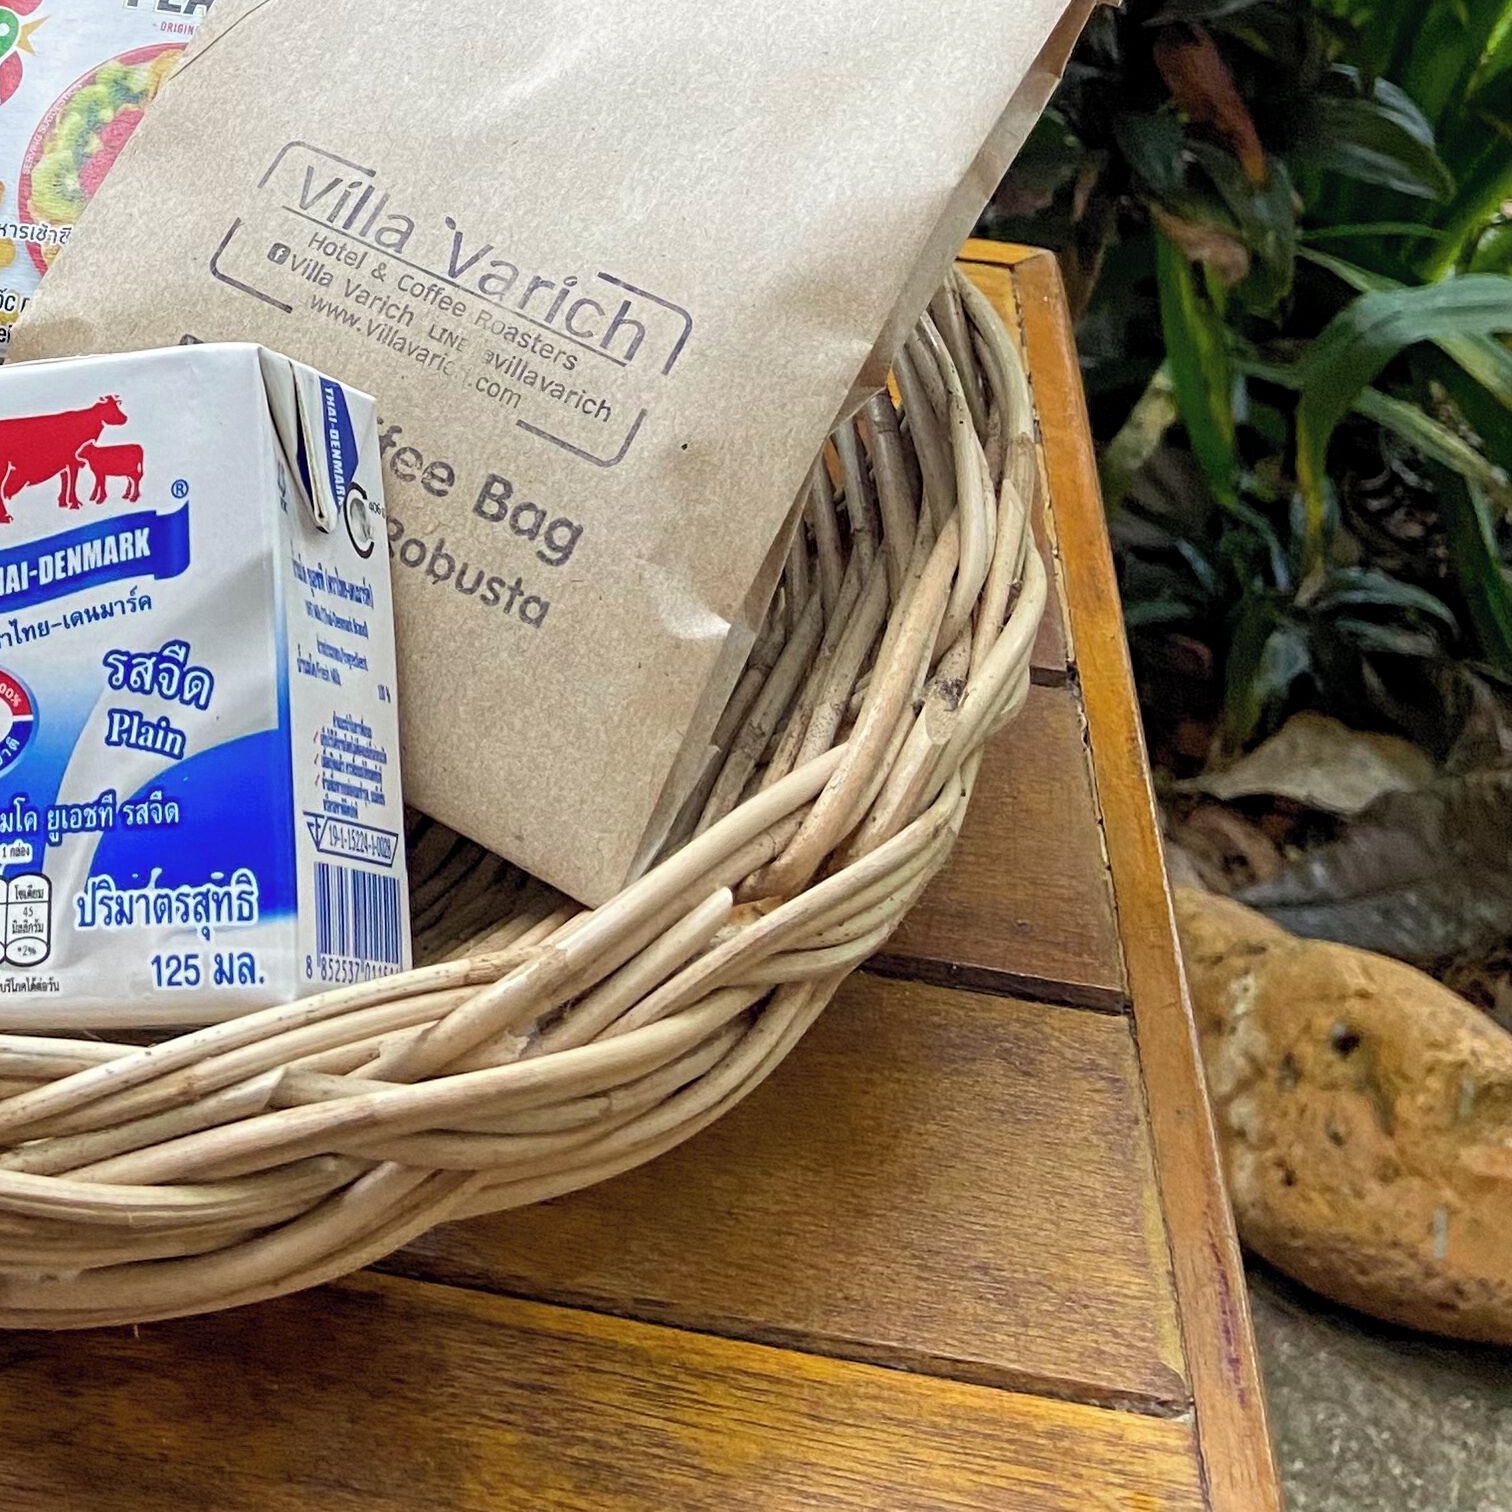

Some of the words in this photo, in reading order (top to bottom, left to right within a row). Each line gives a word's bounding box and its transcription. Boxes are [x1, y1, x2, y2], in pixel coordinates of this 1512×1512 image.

[160, 20, 199, 36] ORIGIN
[296, 165, 415, 253] Villa
[445, 217, 648, 362] Varich
[290, 254, 334, 287] Villa
[344, 278, 415, 328] Varich
[428, 323, 470, 353] LINE
[308, 231, 369, 271] Hotel
[370, 262, 388, 283] &
[397, 274, 467, 318] Coffee
[474, 309, 579, 371] Roasters
[472, 473, 585, 568] Bag
[106, 643, 214, 709] รสจืด
[105, 711, 186, 759] Plain
[46, 793, 116, 845] ยูเอชที
[122, 791, 180, 827] รสจืด
[23, 906, 34, 917] 45
[76, 874, 256, 938] ปริมาตรสุทธิ
[150, 954, 204, 987] 125
[213, 952, 265, 986] มล.
[305, 955, 313, 980] 8
